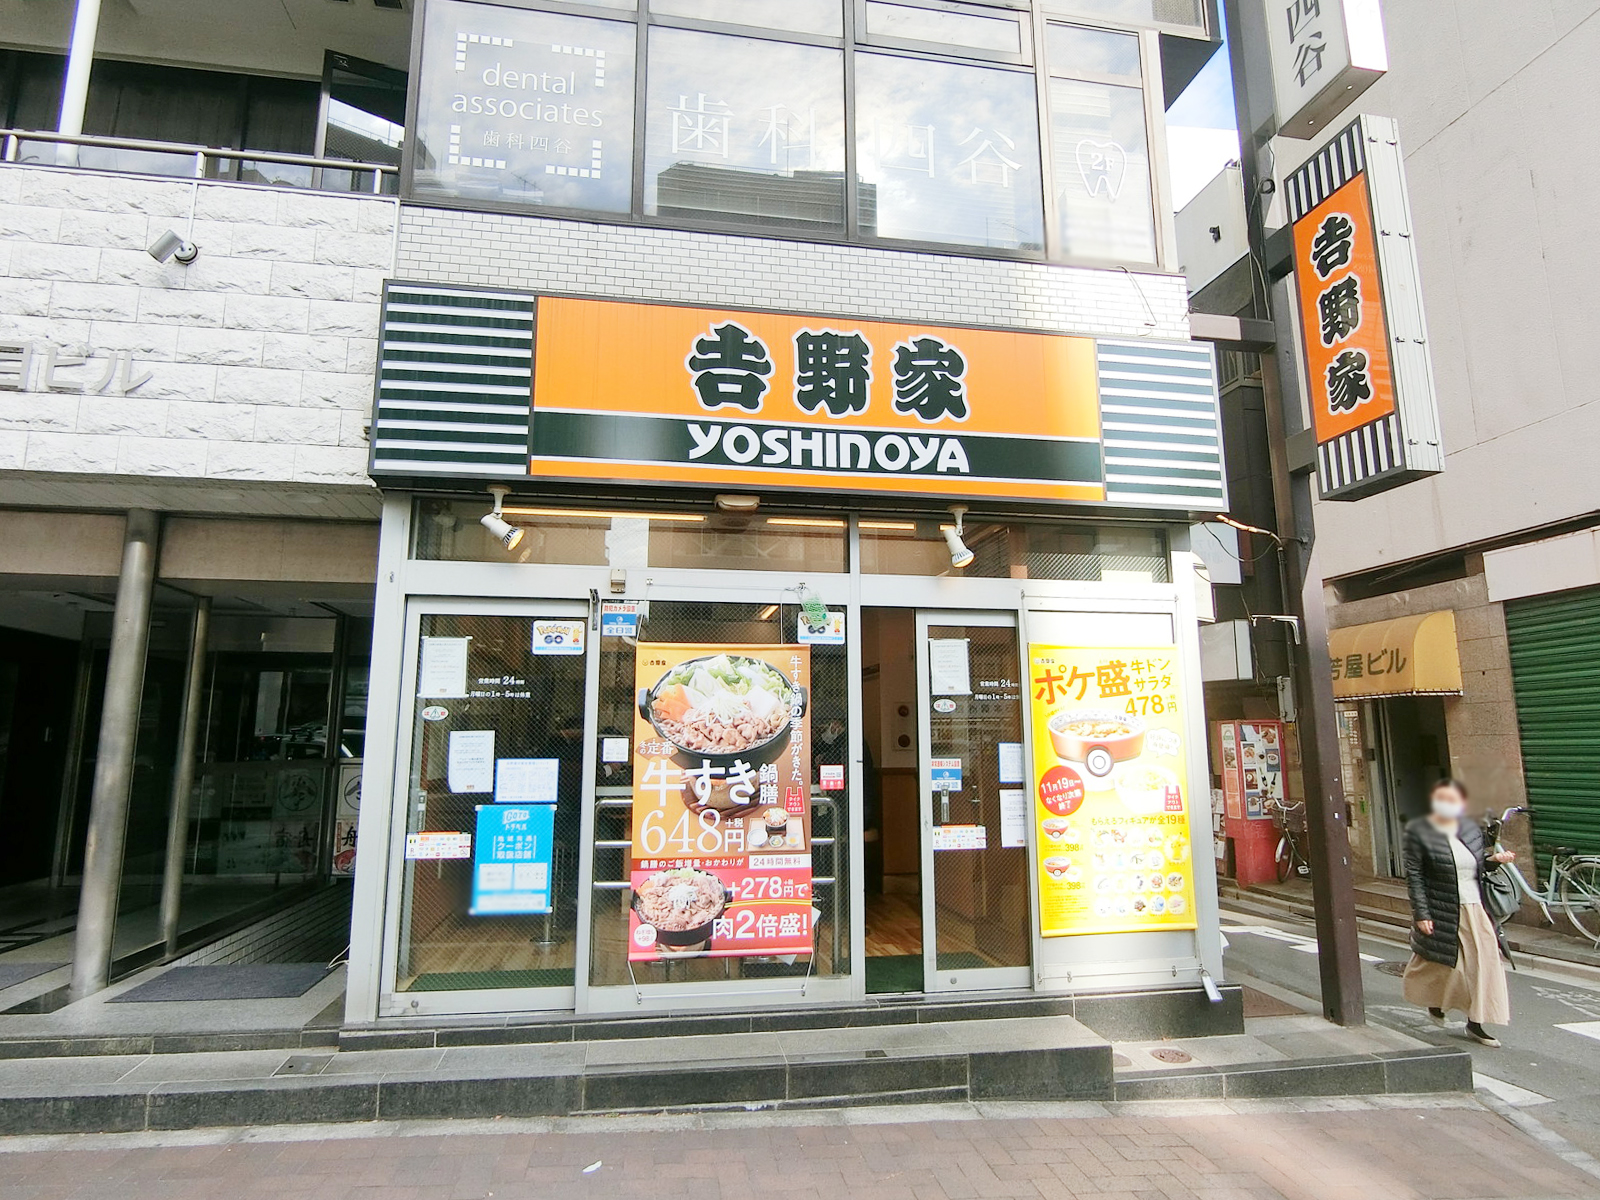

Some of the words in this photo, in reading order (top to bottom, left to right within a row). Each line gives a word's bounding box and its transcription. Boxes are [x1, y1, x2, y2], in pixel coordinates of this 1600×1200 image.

[482, 59, 577, 97] dental
[450, 89, 604, 129] associates
[483, 130, 572, 155] 歯科四谷
[667, 92, 1024, 188] 歯科四谷
[1307, 212, 1375, 416] 吉野家
[688, 322, 971, 422] 吉野家
[686, 423, 971, 474] YOSHINOYA
[1034, 660, 1132, 705] ポケ盛
[1130, 658, 1171, 675] 牛ドン
[641, 758, 760, 808] 牛すき
